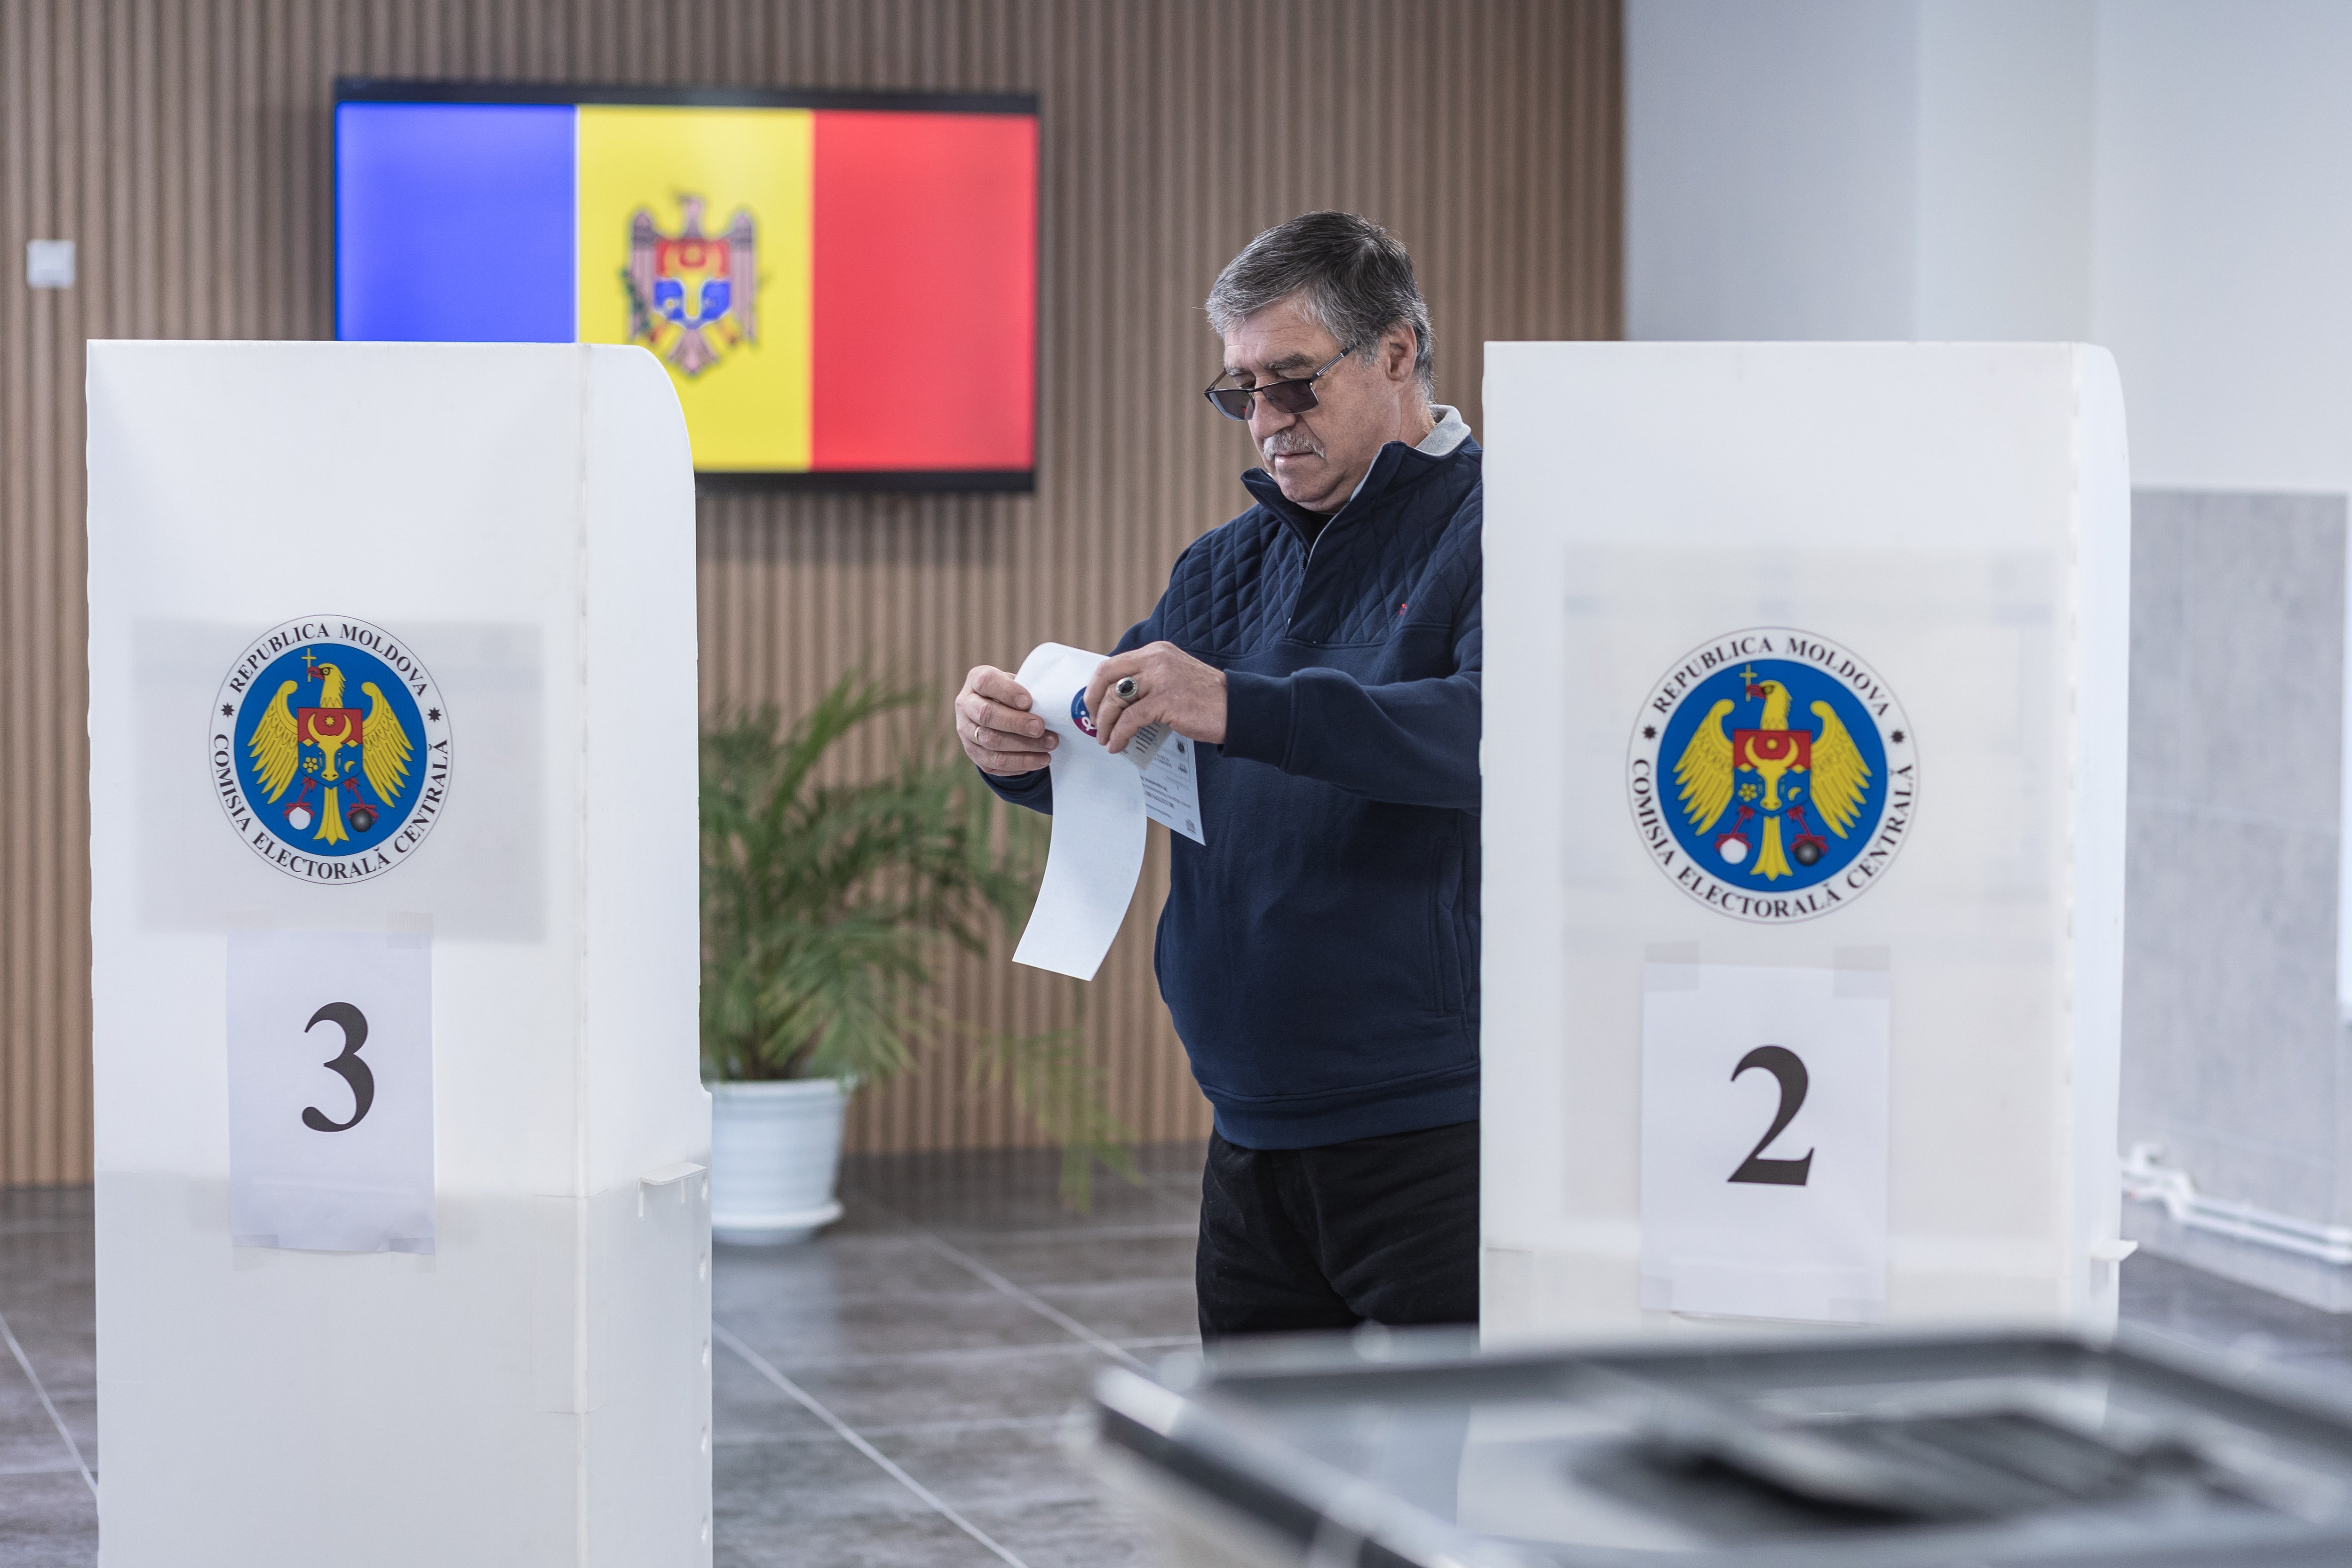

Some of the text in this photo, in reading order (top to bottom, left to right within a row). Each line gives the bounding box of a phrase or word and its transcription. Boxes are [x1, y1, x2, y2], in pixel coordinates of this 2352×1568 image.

[229, 622, 428, 697] REPUBLICA MOLDOVA
[1653, 637, 1889, 716] REPUBLICA MOLDOVA
[214, 734, 448, 879] COMISIA ELECTORALĂ CENTRALĂ
[1633, 758, 1913, 918] COMISIA ELECTORALĂ CENTRALĂ
[302, 1002, 374, 1132] 3
[1727, 1045, 1814, 1186] 2
